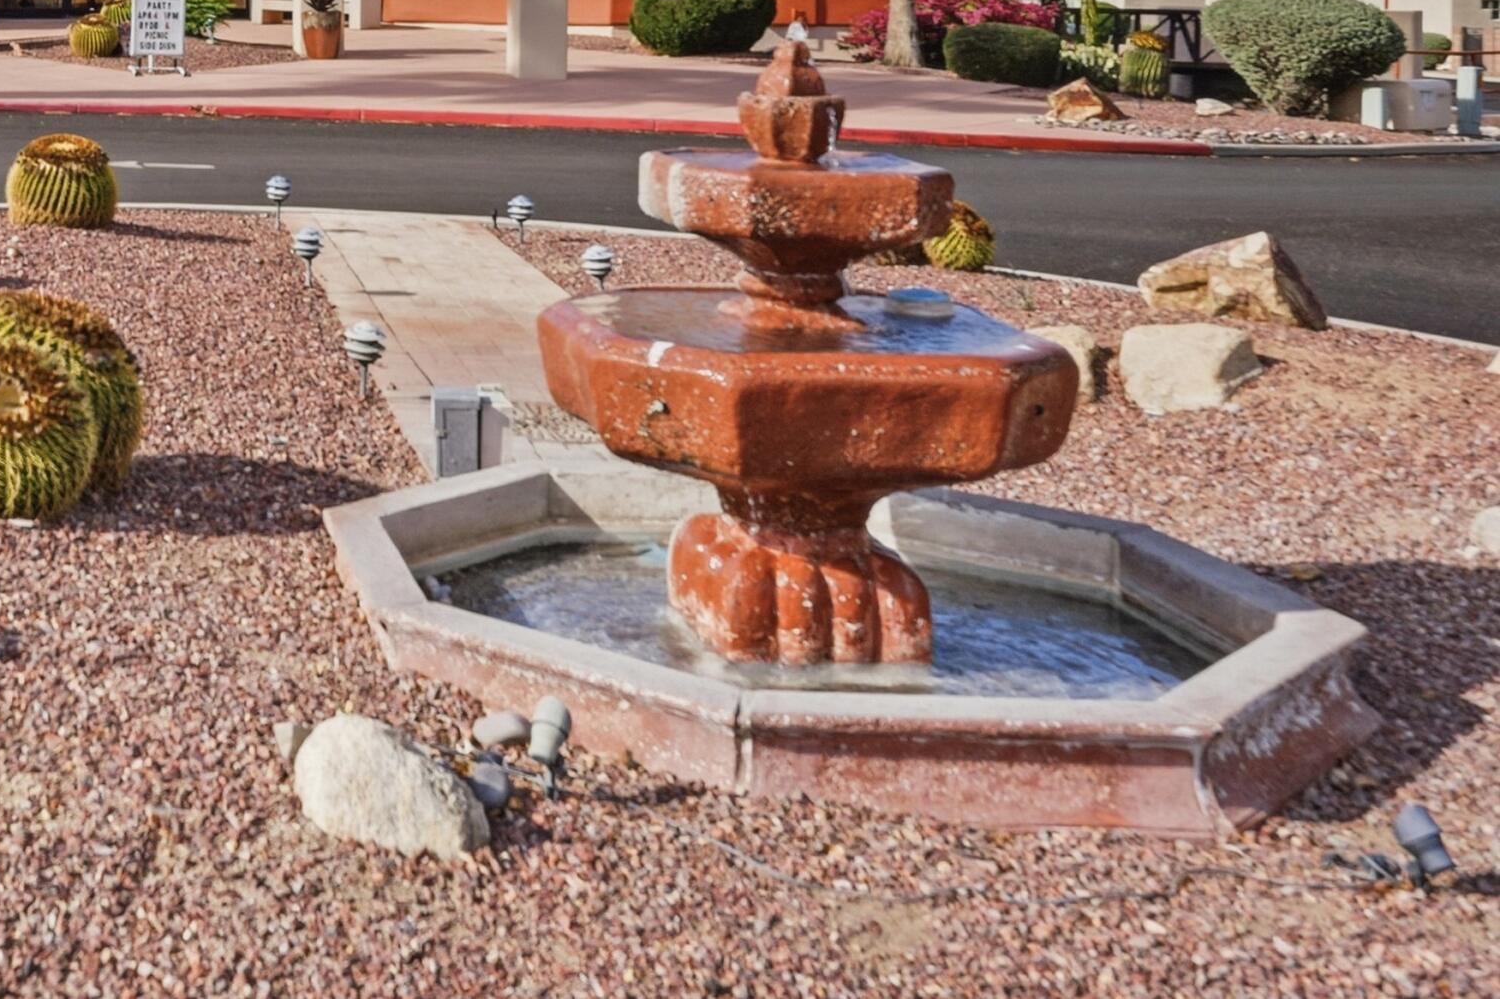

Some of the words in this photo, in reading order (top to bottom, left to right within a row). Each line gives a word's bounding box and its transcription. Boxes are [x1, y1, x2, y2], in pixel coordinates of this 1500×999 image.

[147, 1, 172, 9] PARTY
[144, 31, 169, 39] PICNIC
[139, 41, 156, 50] SIDE
[159, 42, 176, 50] DISH
